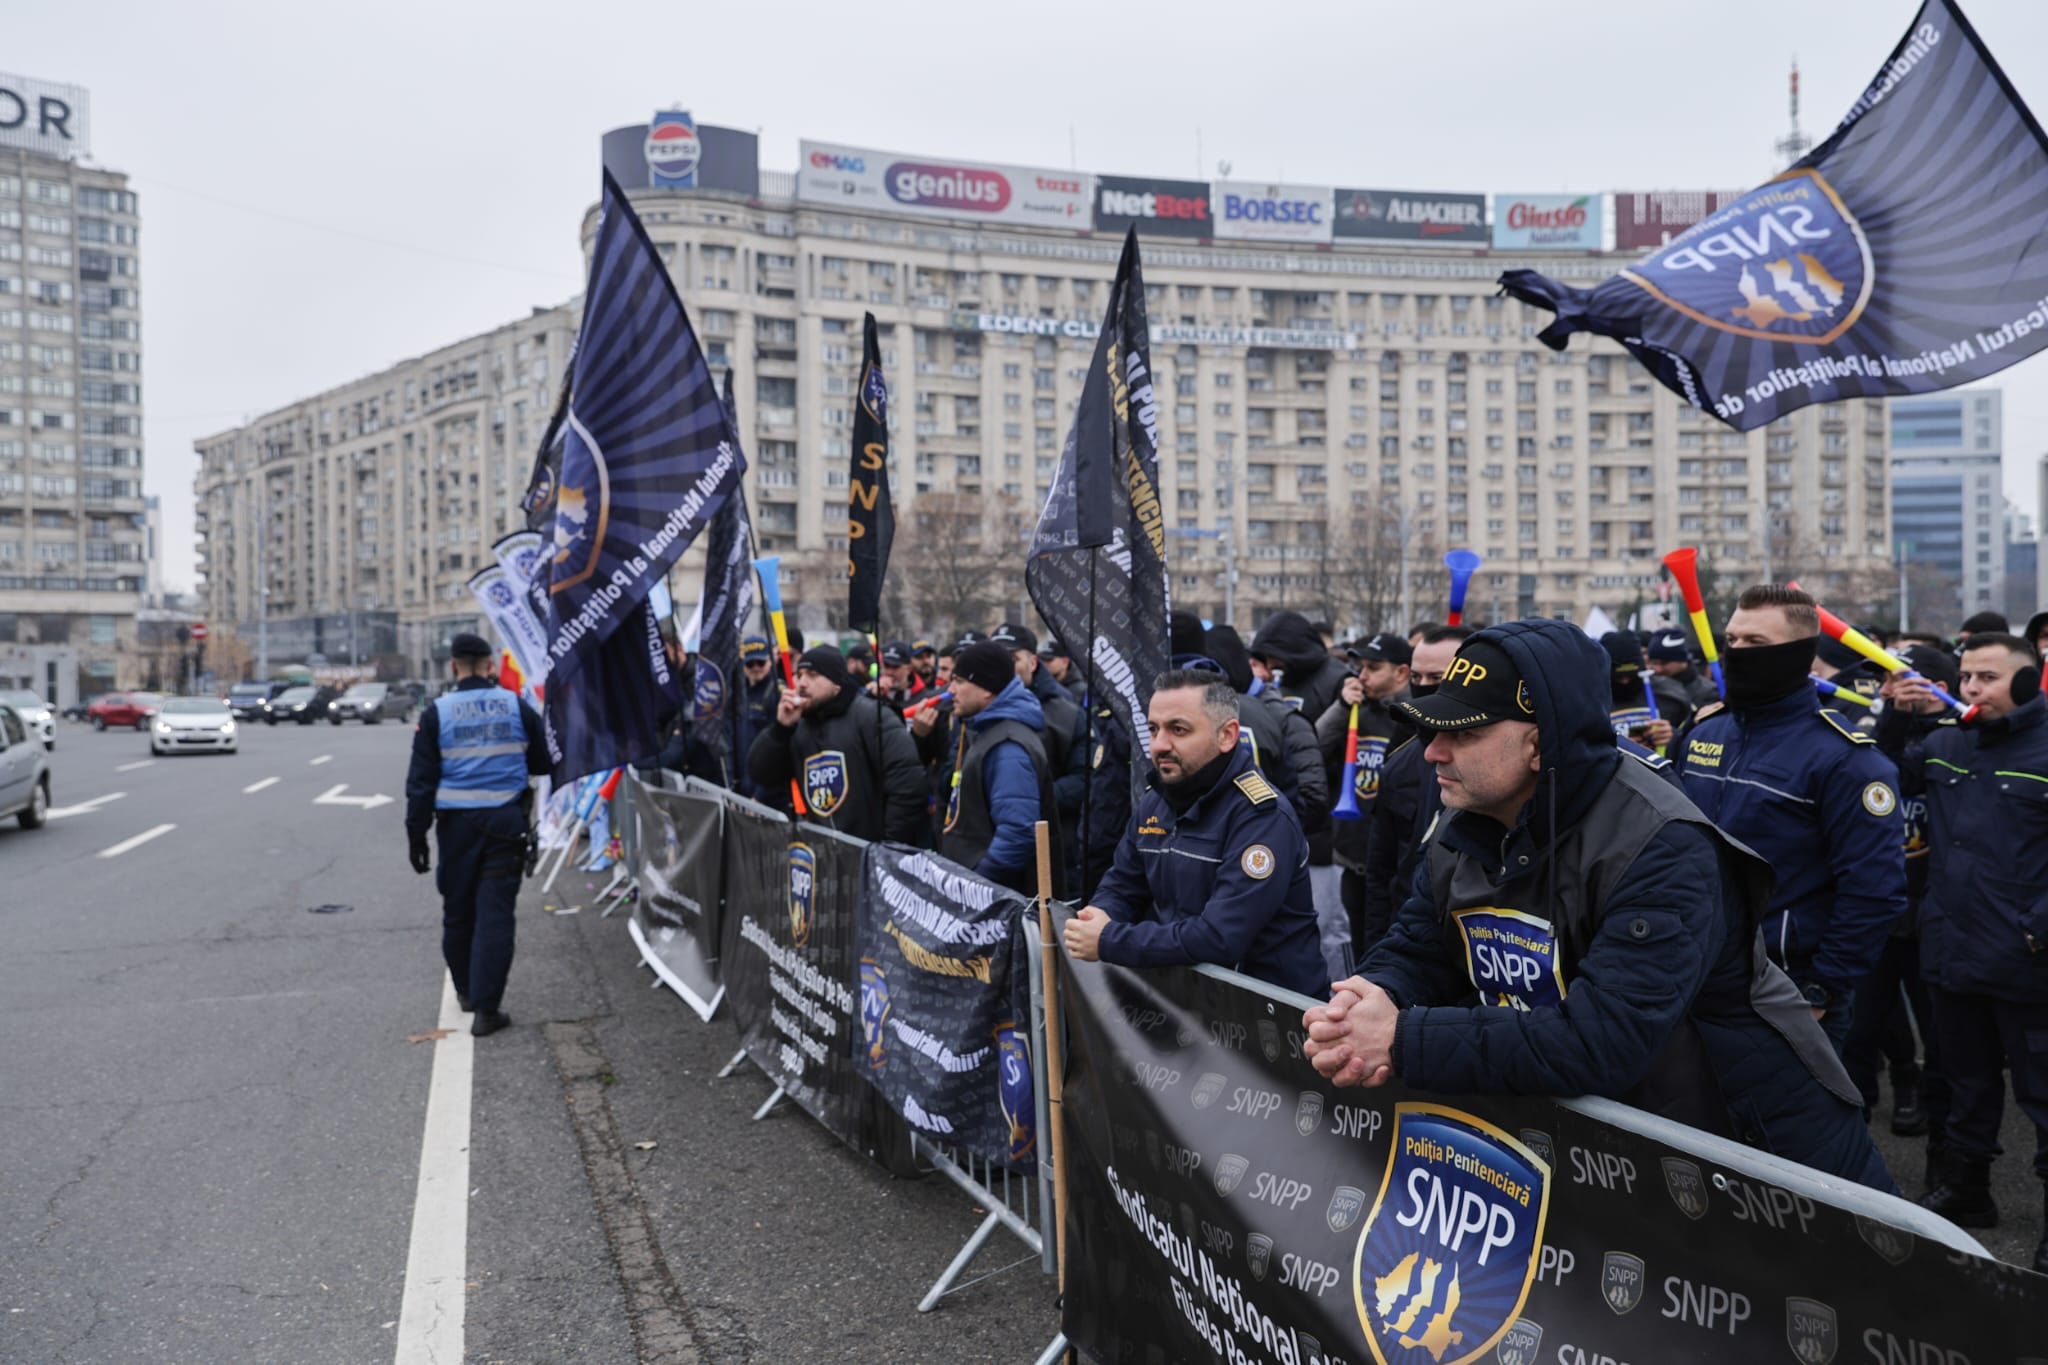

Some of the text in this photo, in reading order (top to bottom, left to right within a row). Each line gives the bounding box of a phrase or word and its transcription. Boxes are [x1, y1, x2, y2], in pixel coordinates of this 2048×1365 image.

[650, 143, 697, 156] PEPSI
[896, 171, 1000, 203] genius
[1101, 190, 1209, 220] NetBet
[1224, 193, 1323, 225] BORSEC
[1386, 198, 1483, 226] ALBACHER
[1507, 202, 1587, 231] Giusto
[978, 314, 1058, 335] EDENT
[1356, 750, 1384, 768] SNP
[1476, 943, 1541, 992] SNPP
[1208, 1020, 1247, 1050] SNPP
[1132, 1062, 1181, 1092] SNPP
[1226, 1087, 1282, 1119] SNPP
[1331, 1104, 1382, 1141] SNPP
[1165, 1144, 1200, 1179] SNPP
[1445, 1146, 1531, 1207] Penitenciară
[1569, 1146, 1637, 1193] SNPP
[1248, 1172, 1312, 1211] SNPP
[1670, 1172, 1698, 1191] SNPP
[1395, 1167, 1516, 1266] SNPP
[1726, 1179, 1817, 1234] SNPP
[1107, 1165, 1199, 1287] Sindicatul
[1278, 1252, 1340, 1297] SNPP
[1608, 1266, 1638, 1286] SNPP
[1170, 1275, 1223, 1355] Filiala
[1661, 1276, 1751, 1335] SNPP
[1505, 1331, 1535, 1349] SNPP
[1794, 1314, 1830, 1337] SNPP
